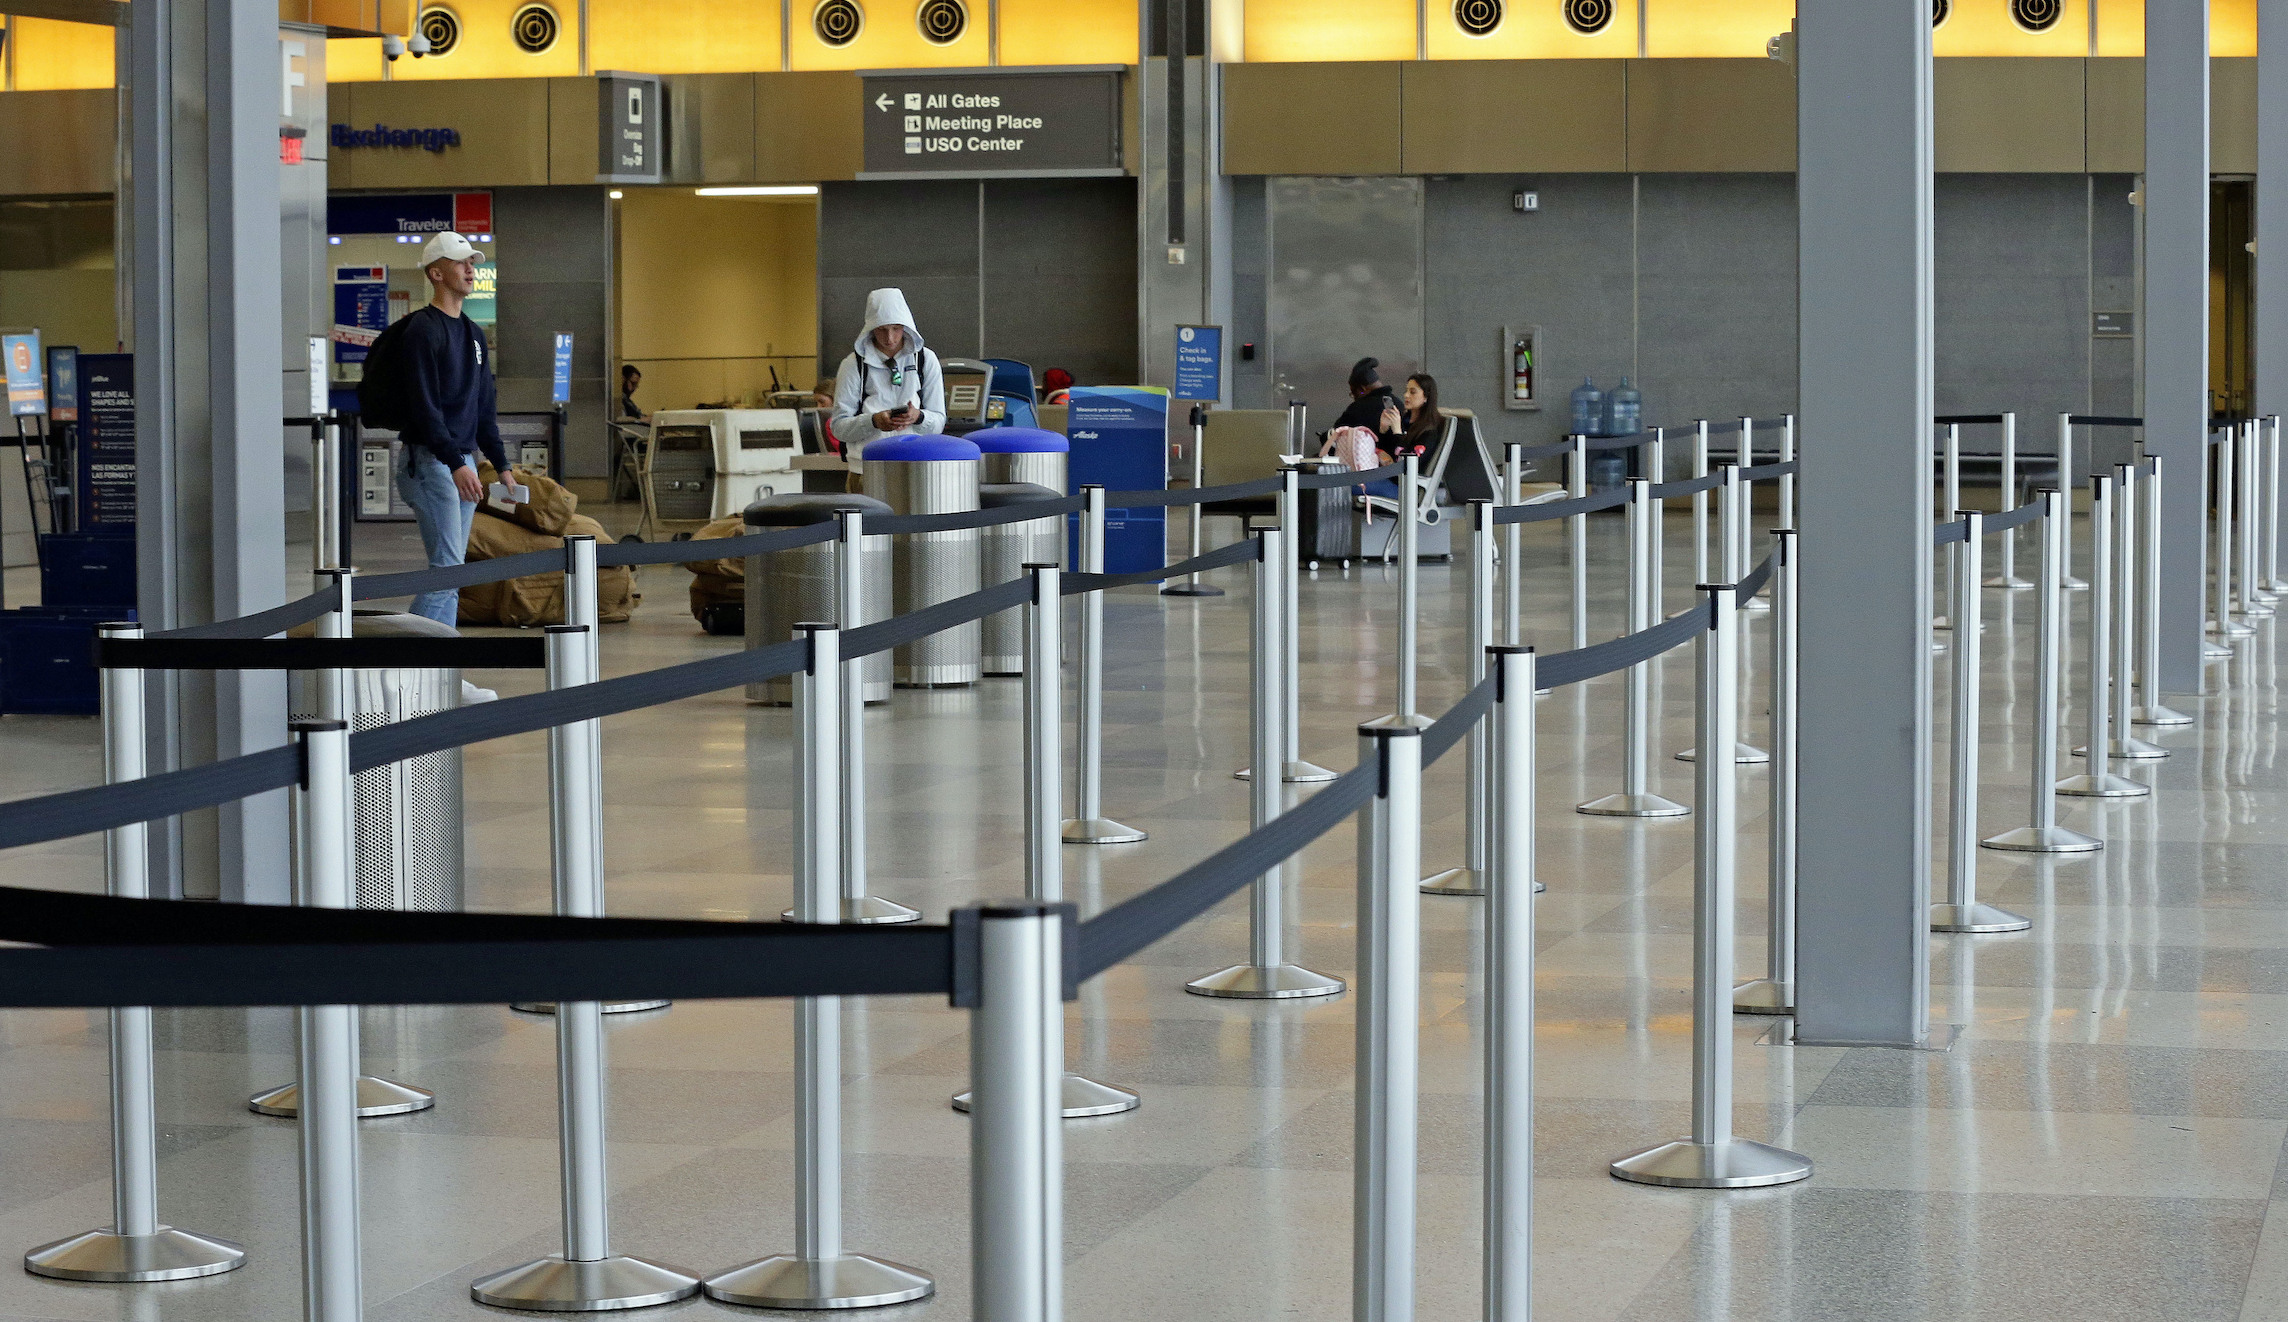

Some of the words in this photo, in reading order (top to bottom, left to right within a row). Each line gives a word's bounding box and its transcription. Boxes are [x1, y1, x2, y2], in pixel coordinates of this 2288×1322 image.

[283, 41, 305, 116] F
[926, 94, 947, 109] All
[951, 93, 1001, 108] Gates
[925, 116, 992, 132] Meeting
[996, 115, 1043, 129] Place
[331, 123, 459, 153] Exchange
[925, 137, 962, 152] USO
[967, 137, 1024, 151] Center
[396, 218, 451, 232] Travelex
[474, 267, 496, 280] ARN
[473, 280, 496, 292] MIL
[1180, 346, 1199, 354] Check
[1185, 356, 1196, 364] tag
[1196, 356, 1213, 364] bags.
